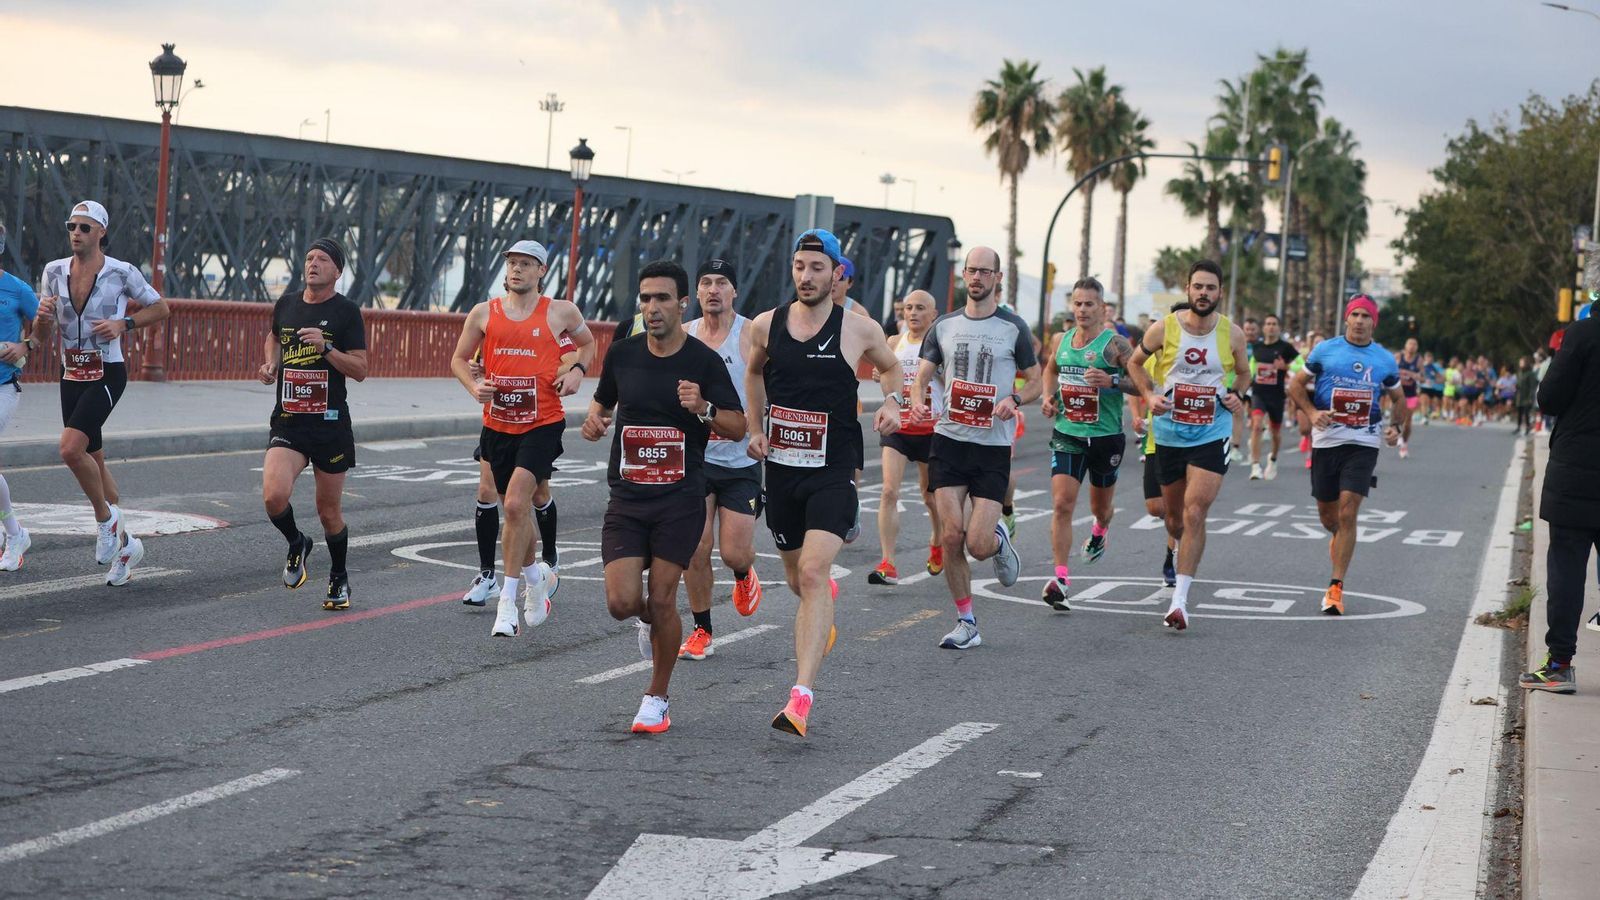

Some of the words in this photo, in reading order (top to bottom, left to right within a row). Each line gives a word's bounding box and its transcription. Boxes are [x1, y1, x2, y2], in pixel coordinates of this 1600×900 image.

[493, 347, 537, 357] INTERVAL
[72, 354, 90, 363] 1692
[293, 372, 324, 380] GENERALI
[499, 379, 532, 387] GENERALI
[295, 385, 312, 395] 966
[961, 383, 993, 394] GENERALI
[499, 392, 522, 403] 2692
[960, 396, 982, 408] 7567
[1069, 397, 1085, 406] 946
[1183, 397, 1205, 408] 5182
[1344, 402, 1360, 410] 979
[781, 411, 822, 424] GENERALI
[637, 430, 681, 439] GENERALI
[779, 428, 811, 443] 16061
[638, 447, 667, 459] 6855
